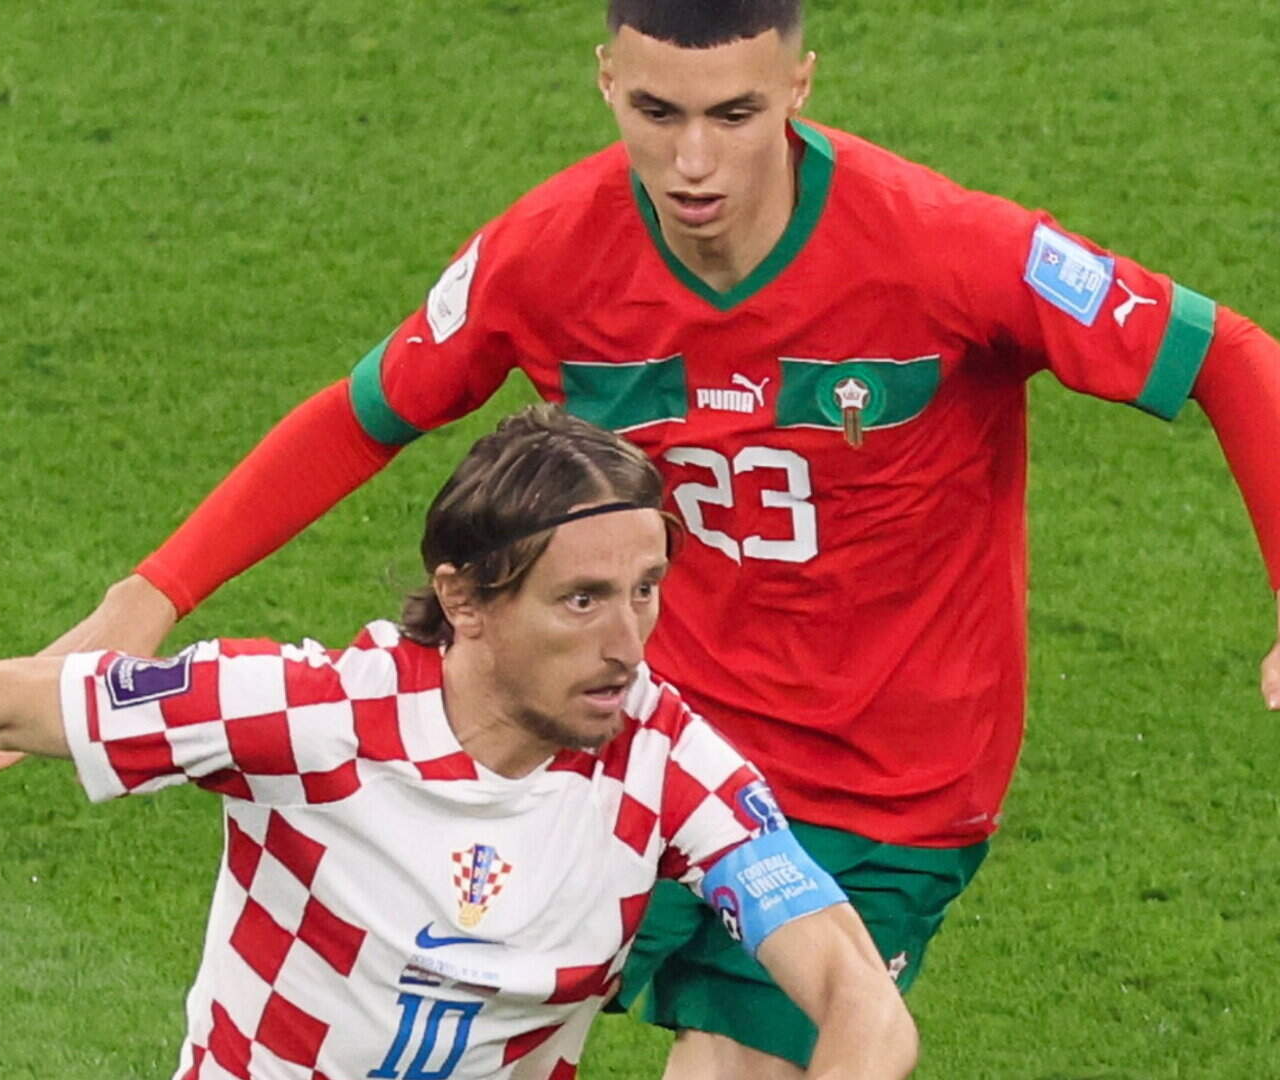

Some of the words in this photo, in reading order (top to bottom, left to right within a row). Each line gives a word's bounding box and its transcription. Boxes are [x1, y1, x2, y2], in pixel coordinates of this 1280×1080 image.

[696, 387, 754, 414] PUMA
[662, 446, 818, 567] 23
[744, 864, 806, 898] UNITES
